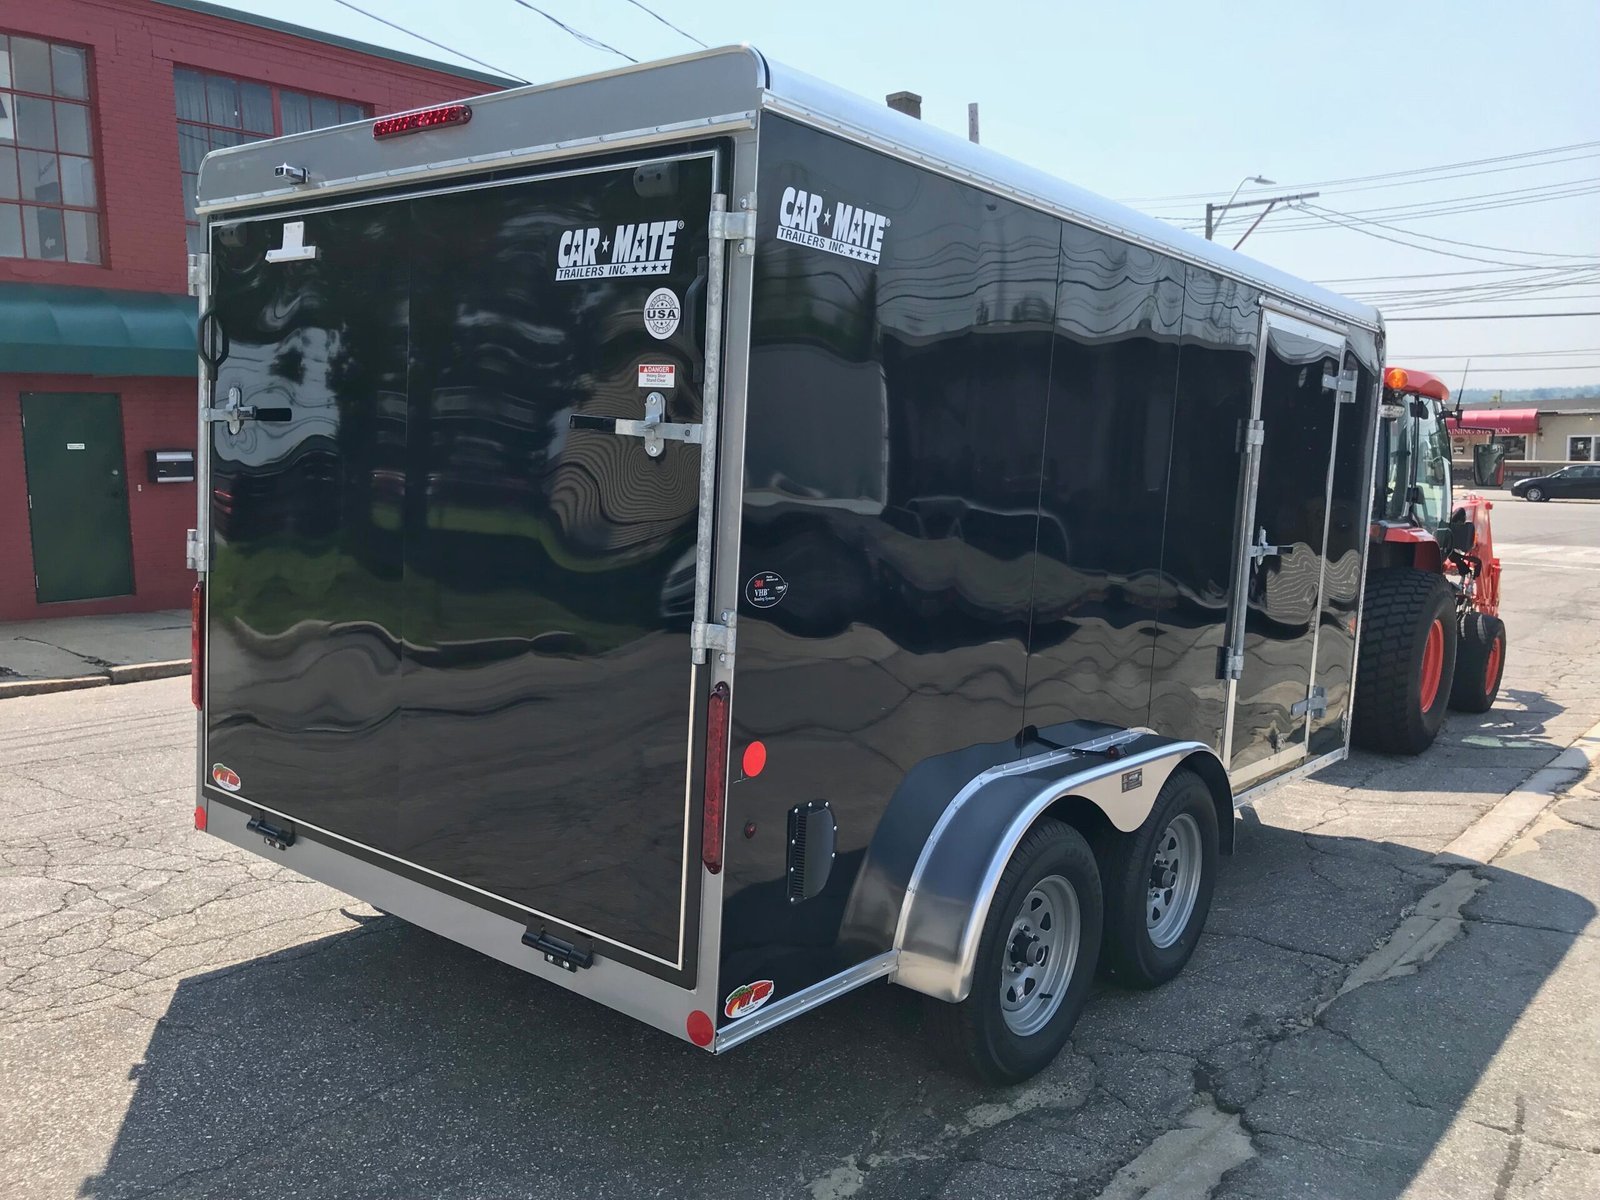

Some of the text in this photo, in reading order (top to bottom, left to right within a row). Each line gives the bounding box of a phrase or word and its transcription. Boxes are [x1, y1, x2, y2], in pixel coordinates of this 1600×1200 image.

[780, 186, 887, 252] CAR MATE
[557, 219, 679, 268] CAR MATE
[780, 227, 847, 255] TRAILERS INC.
[559, 264, 629, 279] TRAILERS INC.
[647, 310, 676, 318] USA
